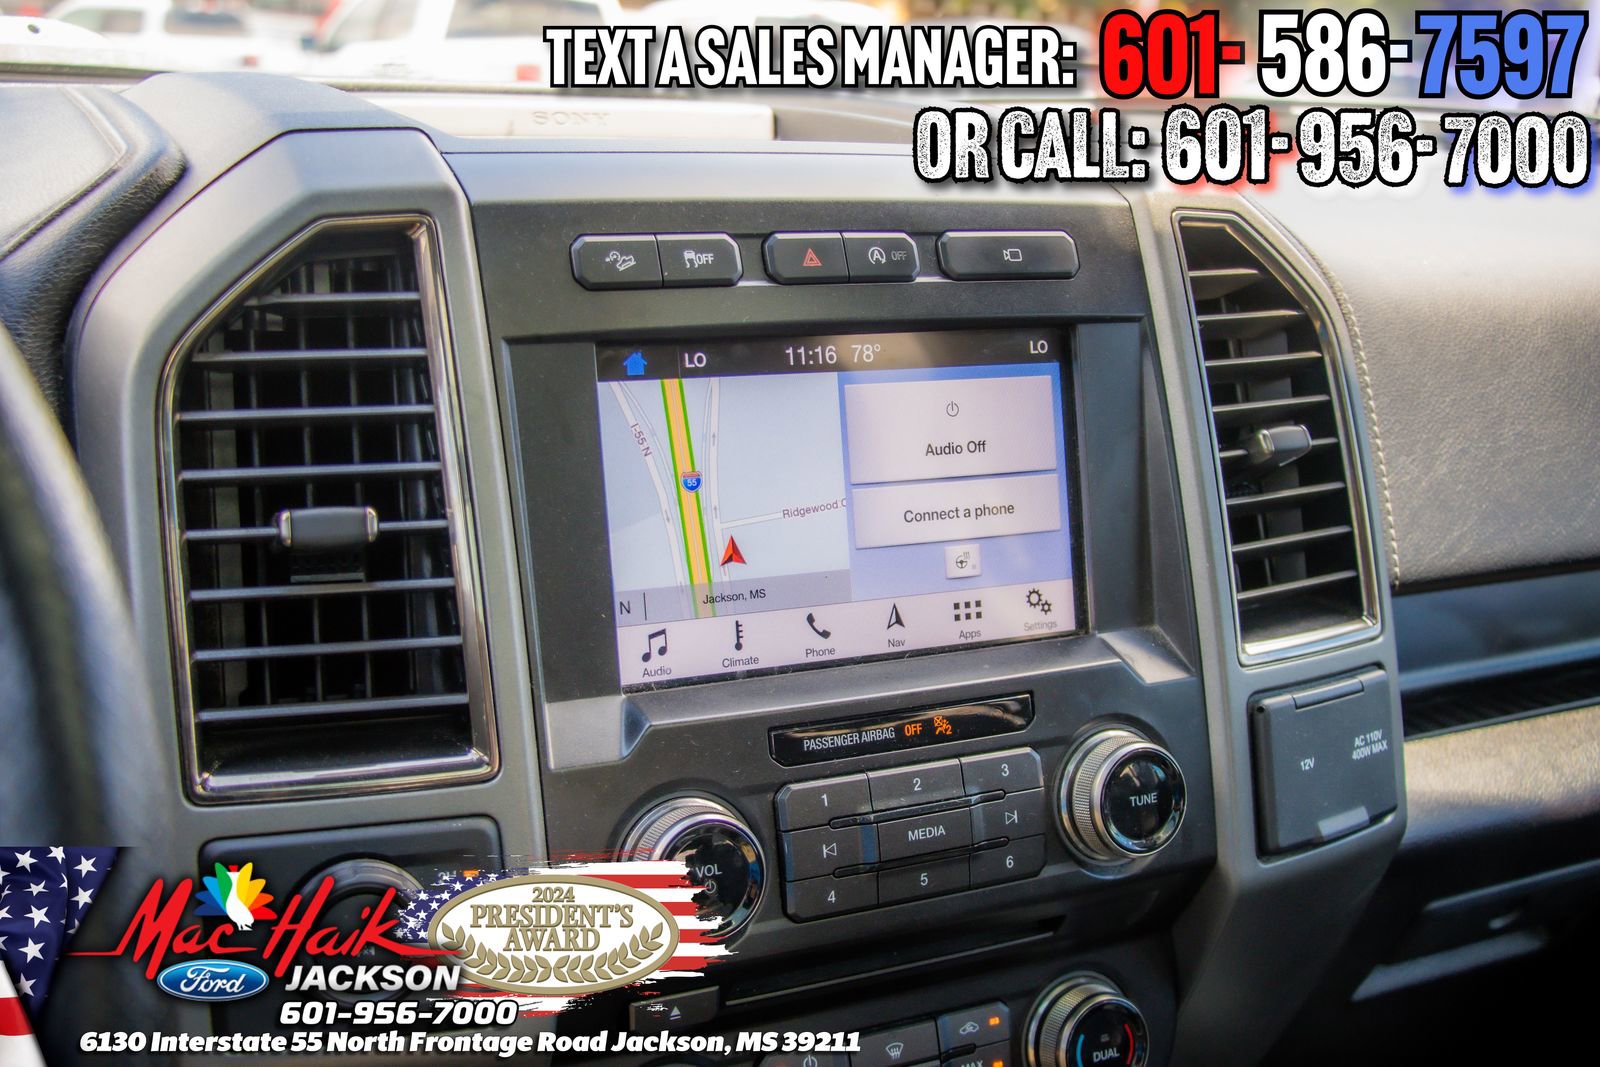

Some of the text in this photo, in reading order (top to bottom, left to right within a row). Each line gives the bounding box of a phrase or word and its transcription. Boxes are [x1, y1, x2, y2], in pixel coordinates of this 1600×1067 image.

[533, 111, 611, 126] SONY
[696, 253, 714, 265] OFF
[891, 250, 907, 261] OFF
[1029, 340, 1048, 354] LO
[684, 352, 707, 368] LO
[785, 346, 838, 366] 11:16
[642, 446, 652, 457] N
[925, 440, 986, 457] Audio Off
[687, 478, 698, 487] 55
[782, 500, 839, 519] Ridgewood
[903, 502, 1015, 523] Connect a phone
[702, 588, 767, 605] Jackson, MS
[619, 601, 631, 615] N
[1023, 620, 1058, 632] Settings
[958, 628, 982, 640] Apps
[887, 638, 906, 648] Nav
[805, 646, 836, 658] Phone
[722, 656, 759, 668] Climate
[642, 667, 672, 678] Audio
[803, 735, 860, 751] PASSENGER
[861, 728, 895, 743] AIRBAG
[904, 723, 922, 737] OFF
[1354, 729, 1383, 747] AC 110V
[1352, 741, 1388, 760] 400W MAX
[1001, 764, 1009, 777] 3
[1300, 757, 1315, 771] 12V
[913, 778, 921, 791] 2
[821, 794, 828, 807] 1
[1129, 792, 1158, 807] TUNE
[908, 825, 946, 842] MEDIA
[1006, 856, 1014, 869] 6
[696, 864, 722, 878] VOL
[920, 874, 928, 886] 5
[827, 891, 836, 904] 4
[1093, 1048, 1120, 1063] DUAL
